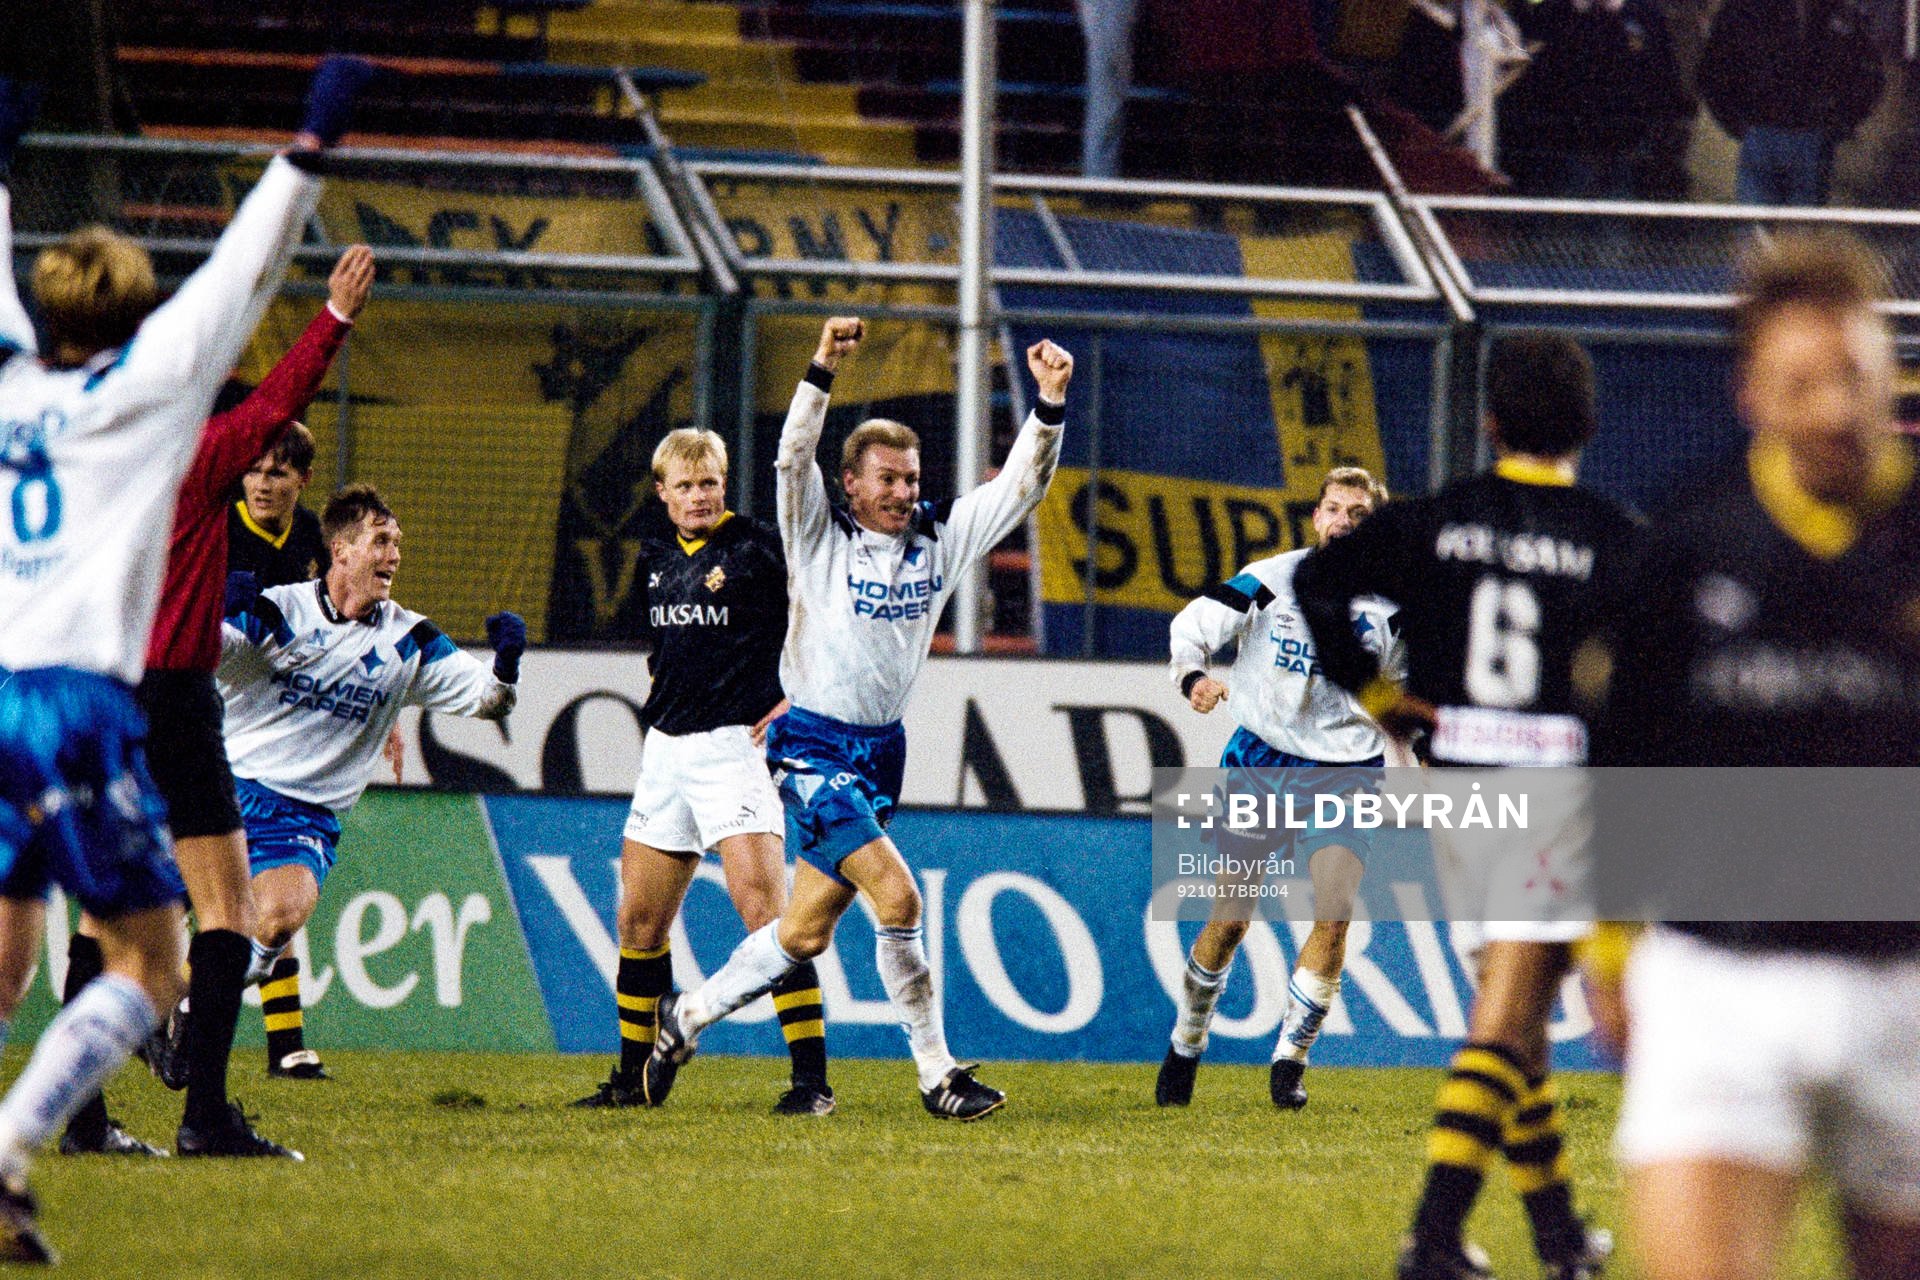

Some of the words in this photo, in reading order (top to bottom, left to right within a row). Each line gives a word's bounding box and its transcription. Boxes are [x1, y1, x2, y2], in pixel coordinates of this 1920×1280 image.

[303, 200, 552, 288] ACK
[847, 573, 943, 602] HOMEN
[650, 604, 729, 627] OLKSAM
[1465, 573, 1541, 706] 6
[271, 671, 391, 707] HOLMEN
[279, 689, 370, 724] PAPER
